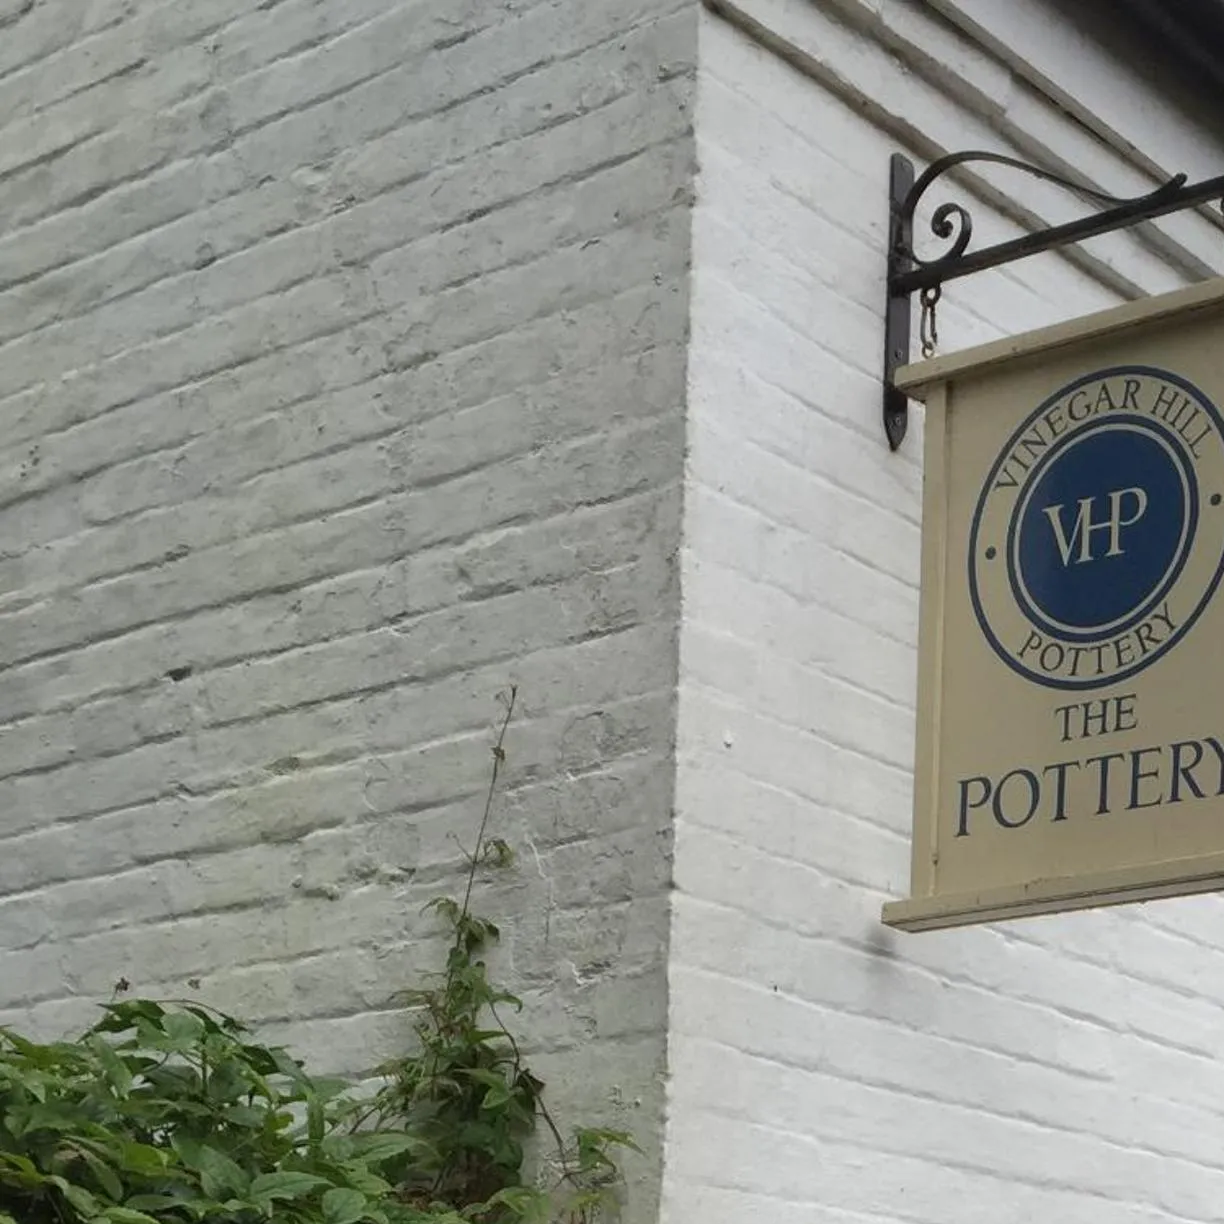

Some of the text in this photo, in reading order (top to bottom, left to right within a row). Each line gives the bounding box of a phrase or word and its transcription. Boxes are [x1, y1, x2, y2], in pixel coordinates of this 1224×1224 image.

[995, 379, 1214, 492] VINEGAR HILL
[1042, 486, 1148, 567] VHP
[1016, 602, 1177, 677] POTTERY
[1055, 693, 1138, 742] THE
